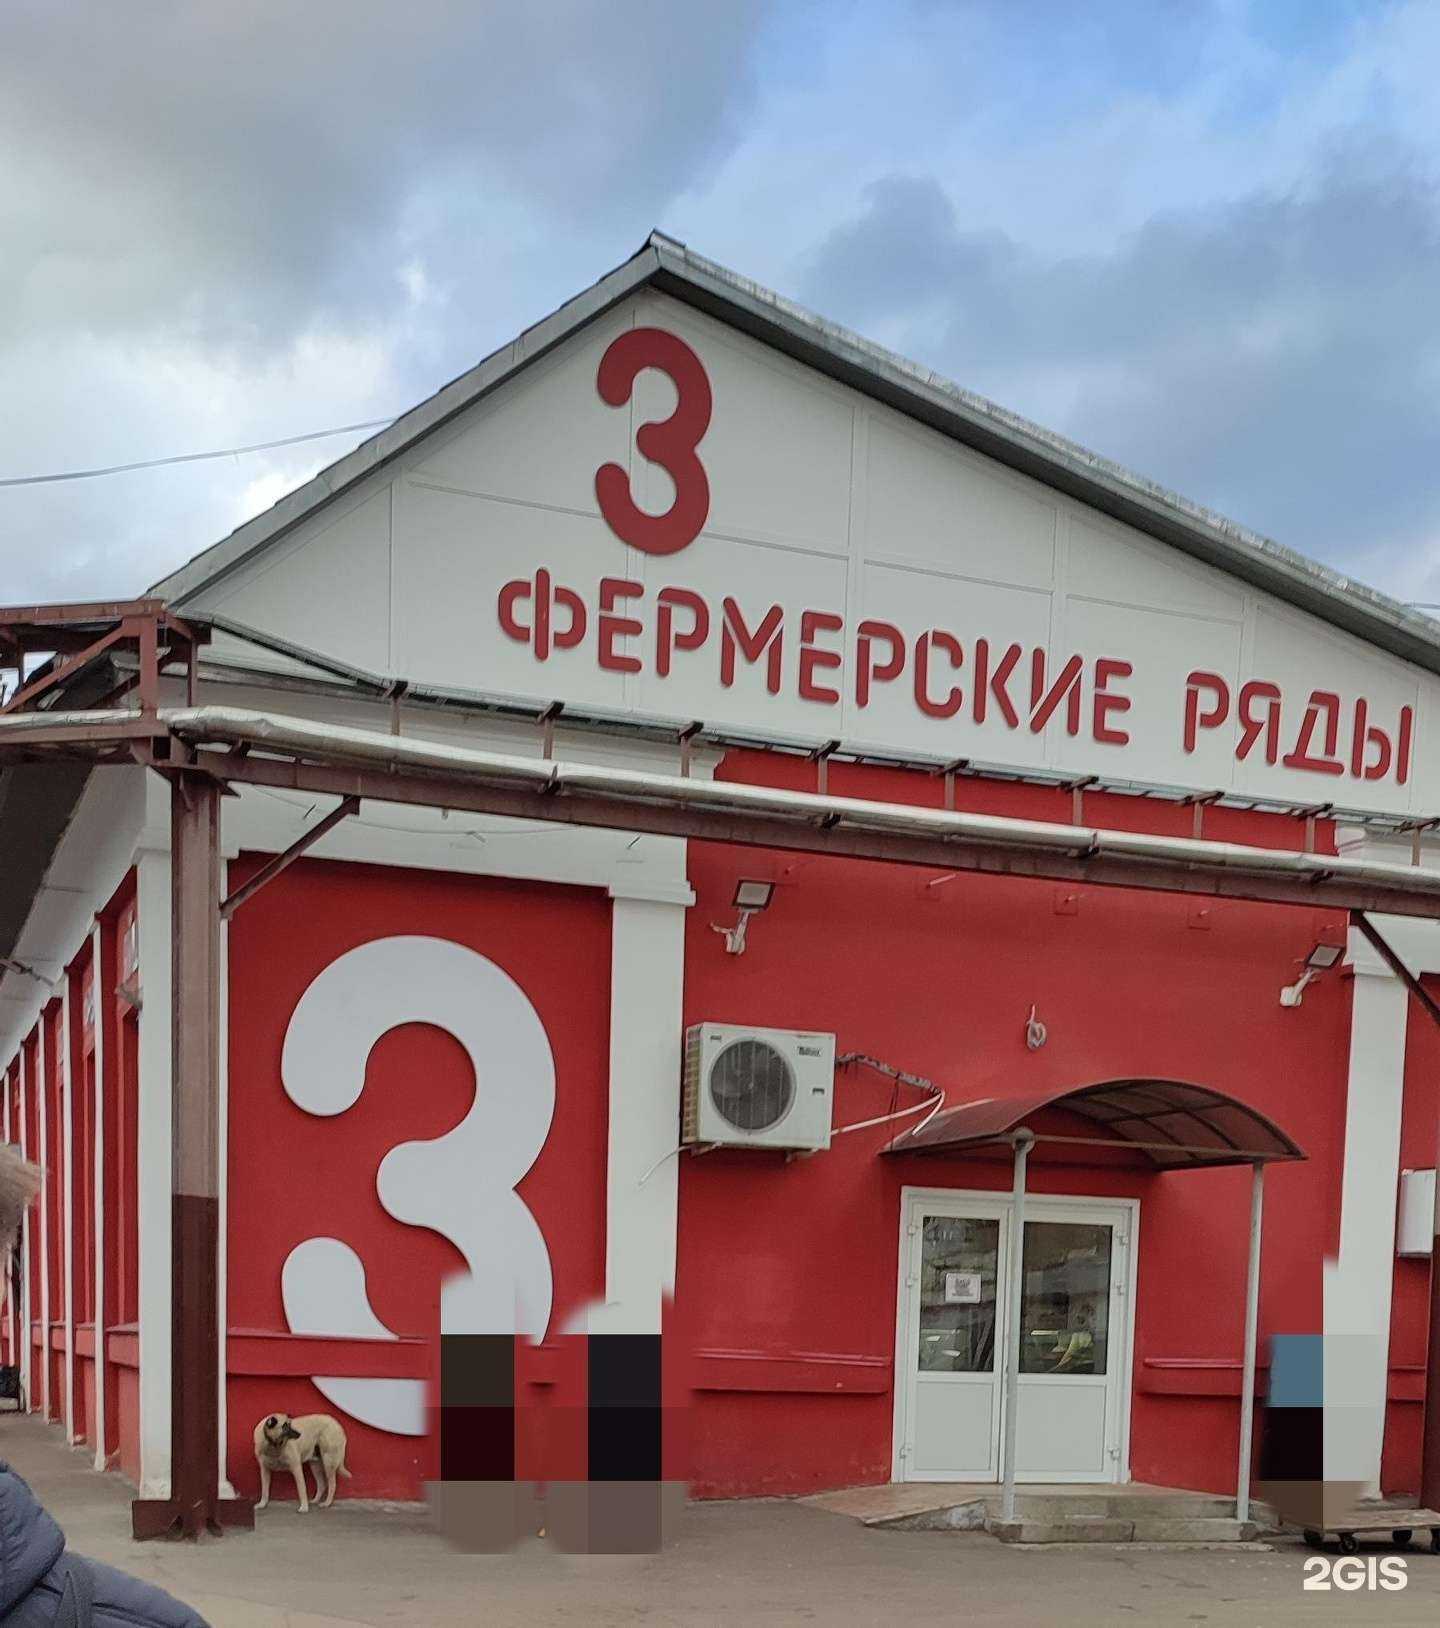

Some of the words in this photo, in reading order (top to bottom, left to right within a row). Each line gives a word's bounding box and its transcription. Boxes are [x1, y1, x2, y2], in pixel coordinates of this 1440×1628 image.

[596, 329, 714, 556] 3
[498, 568, 1134, 745] ФЕРМЕРСКИЕ
[1183, 671, 1414, 785] РЯДЫ
[281, 935, 557, 1437] 3
